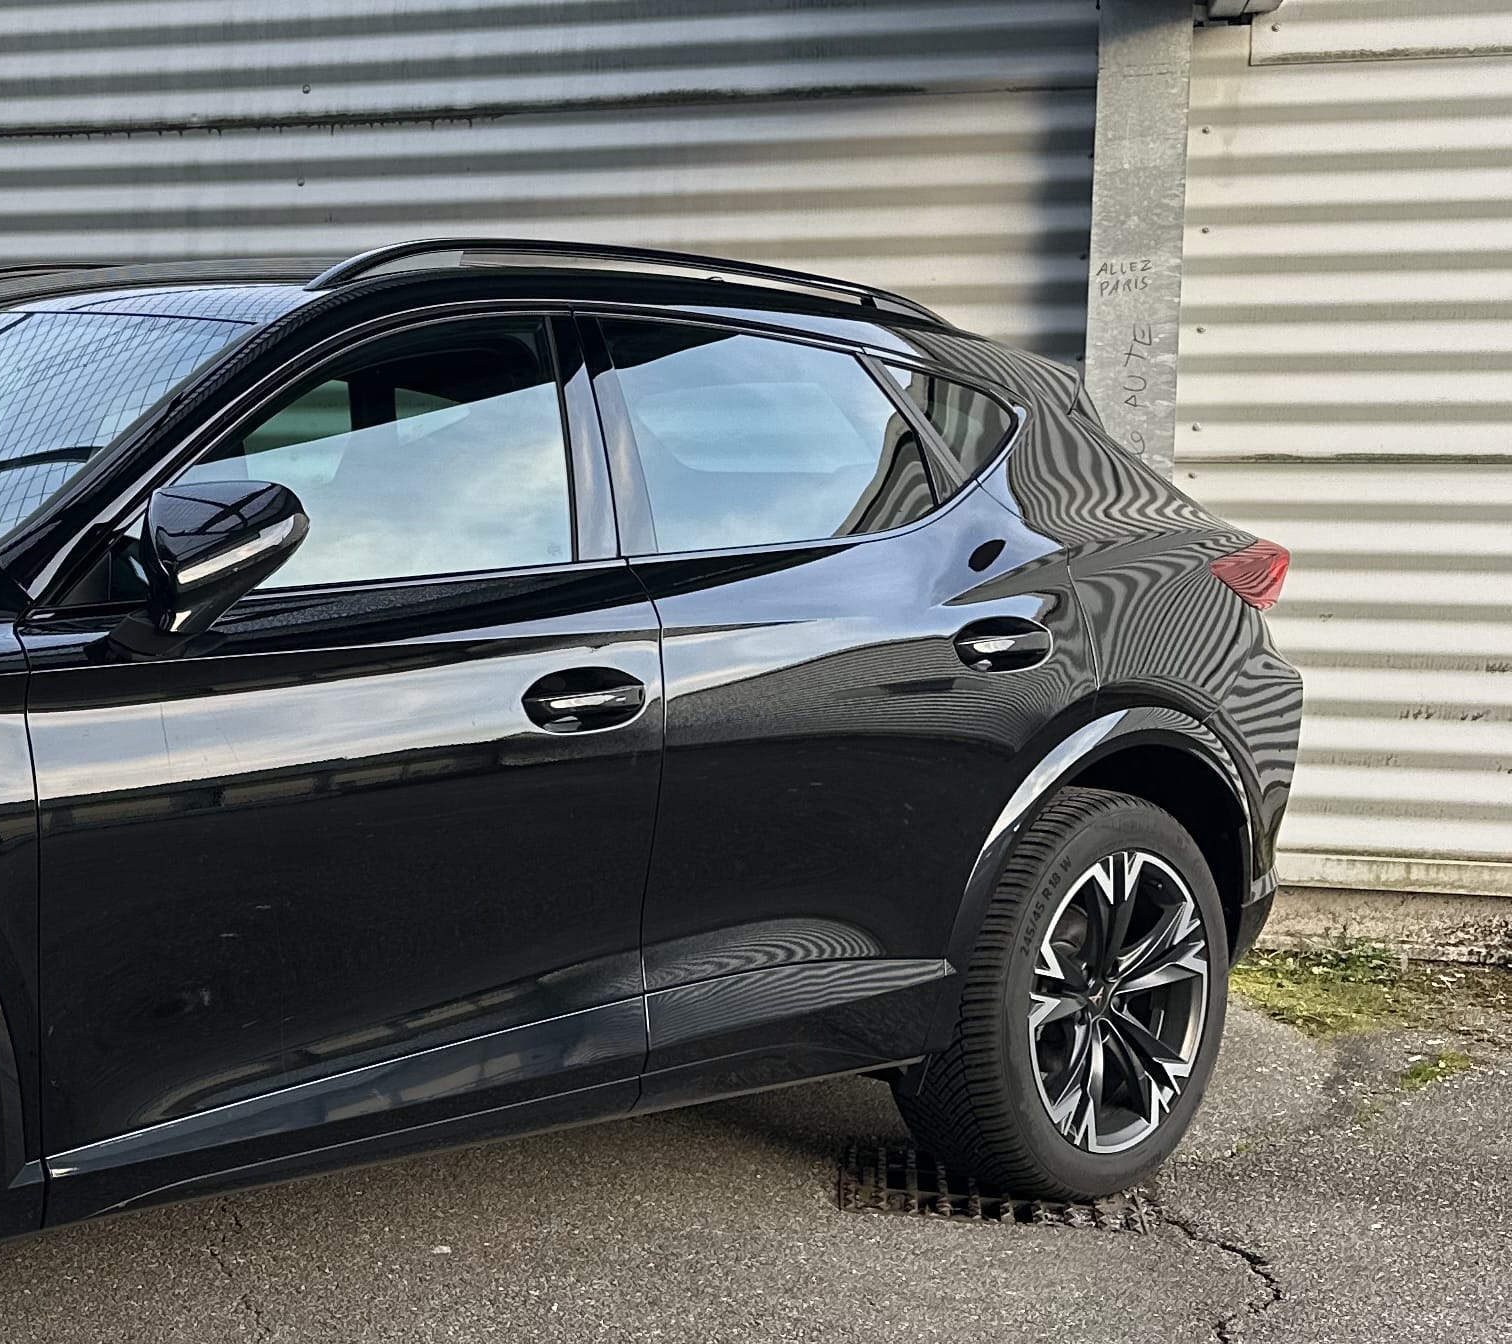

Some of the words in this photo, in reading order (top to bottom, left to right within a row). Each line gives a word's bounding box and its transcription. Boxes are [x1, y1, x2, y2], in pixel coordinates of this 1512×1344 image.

[1096, 259, 1153, 277] ALLEZ
[1099, 275, 1150, 297] PARIS
[1122, 323, 1153, 408] PUTE
